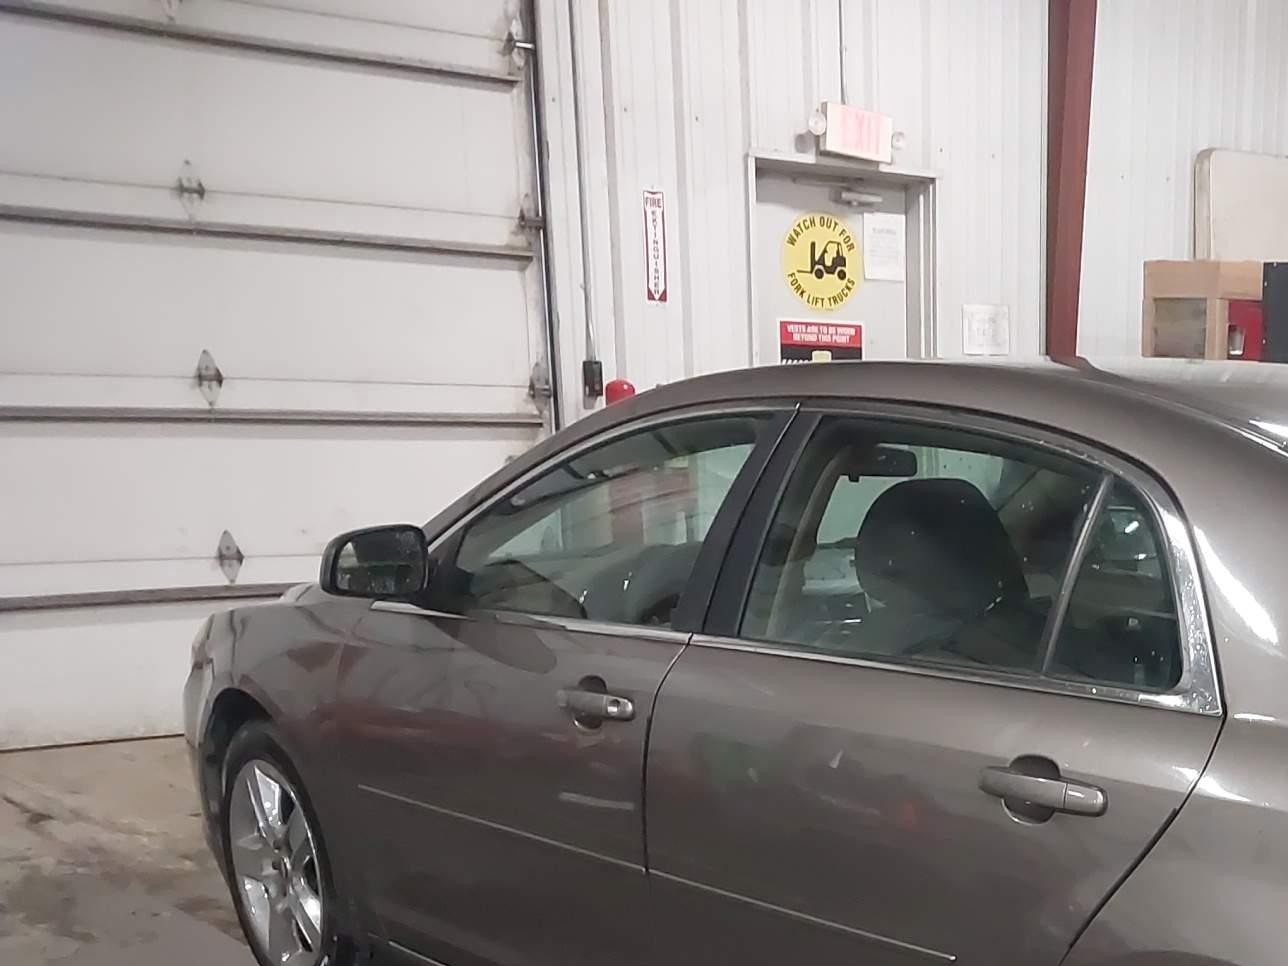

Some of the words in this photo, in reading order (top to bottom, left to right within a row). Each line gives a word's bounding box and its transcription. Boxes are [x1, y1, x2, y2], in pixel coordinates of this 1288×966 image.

[645, 197, 662, 208] FIRE
[786, 216, 816, 247] WATCH
[819, 215, 839, 232] OUT
[839, 228, 855, 252] FOR
[651, 210, 660, 295] EXTINGUISHER
[787, 272, 806, 299] FORK
[807, 293, 825, 308] LIFT
[827, 277, 856, 307] TRUCKS
